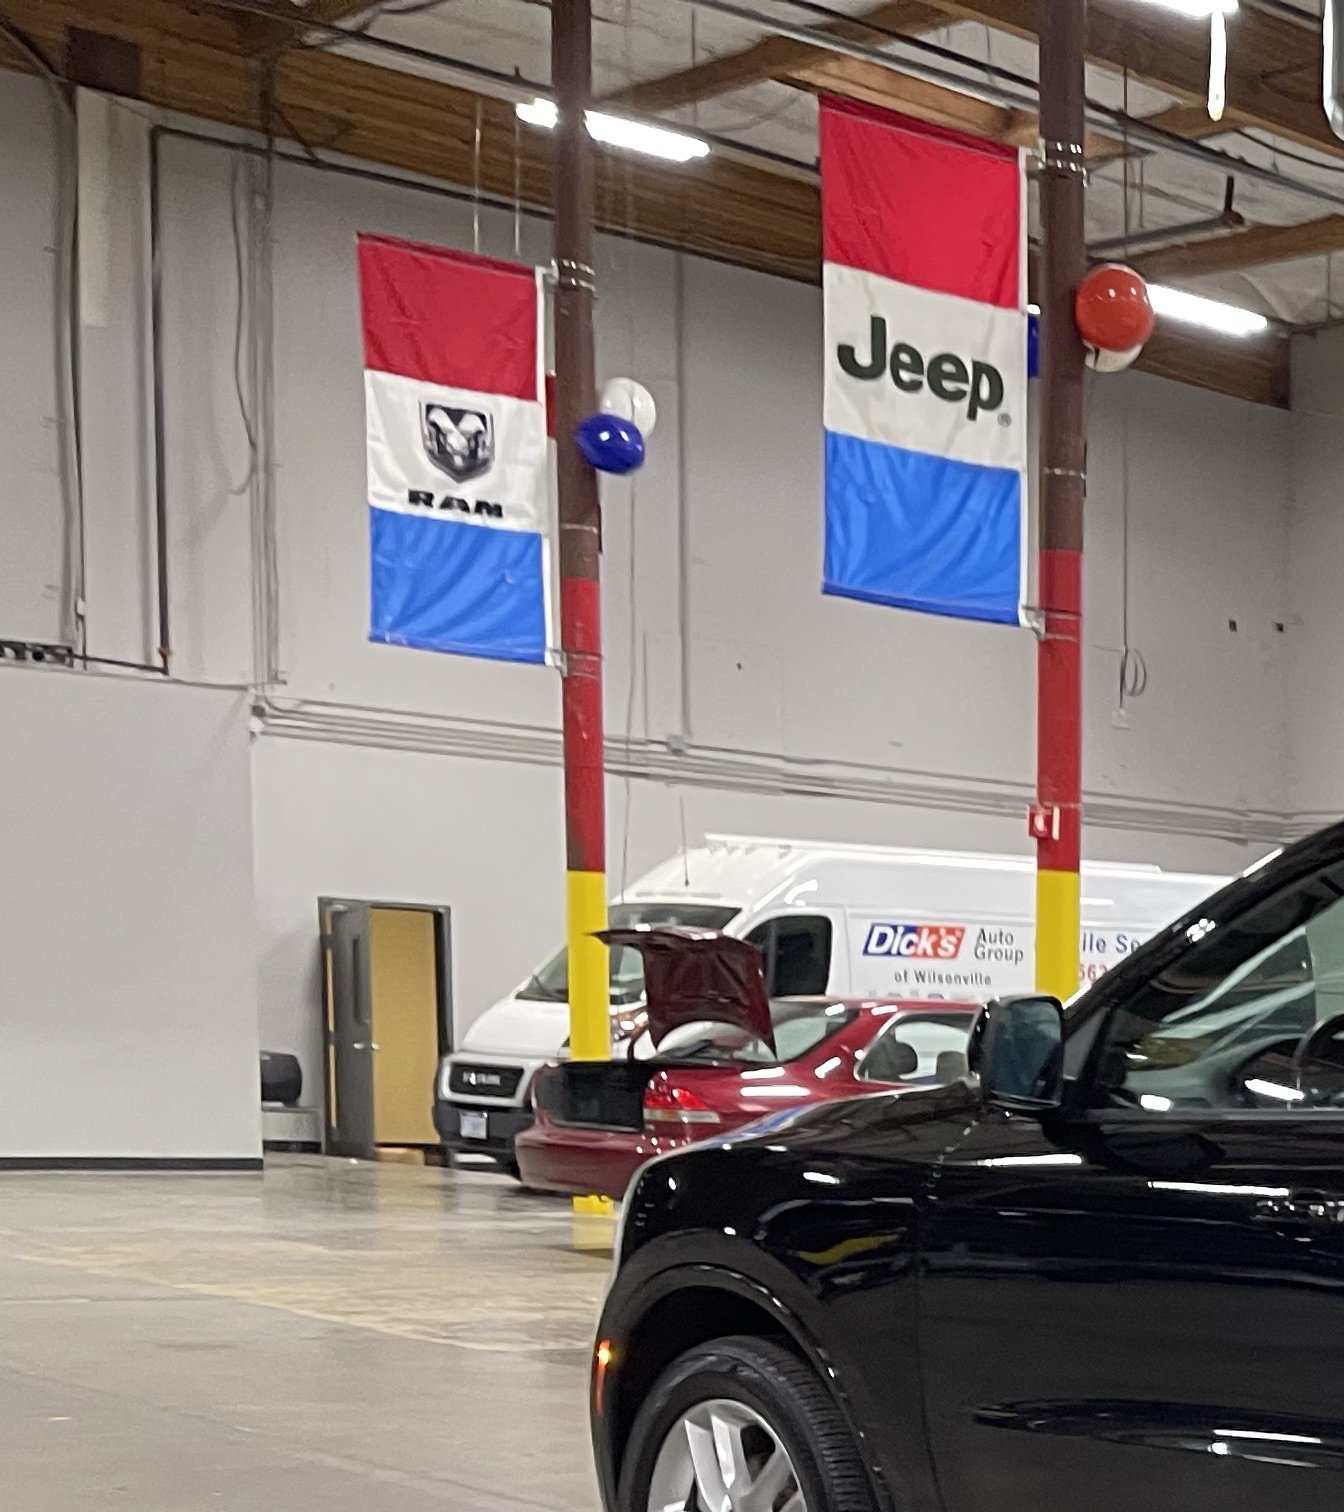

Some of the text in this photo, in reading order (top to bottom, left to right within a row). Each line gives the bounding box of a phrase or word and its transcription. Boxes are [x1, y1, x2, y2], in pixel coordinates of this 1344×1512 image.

[837, 314, 1004, 421] Jeep
[408, 488, 503, 519] RAM
[866, 925, 958, 958] Dick's
[976, 928, 1014, 946] Auto
[974, 945, 1024, 966] Group
[894, 969, 992, 986] of Wilsonville
